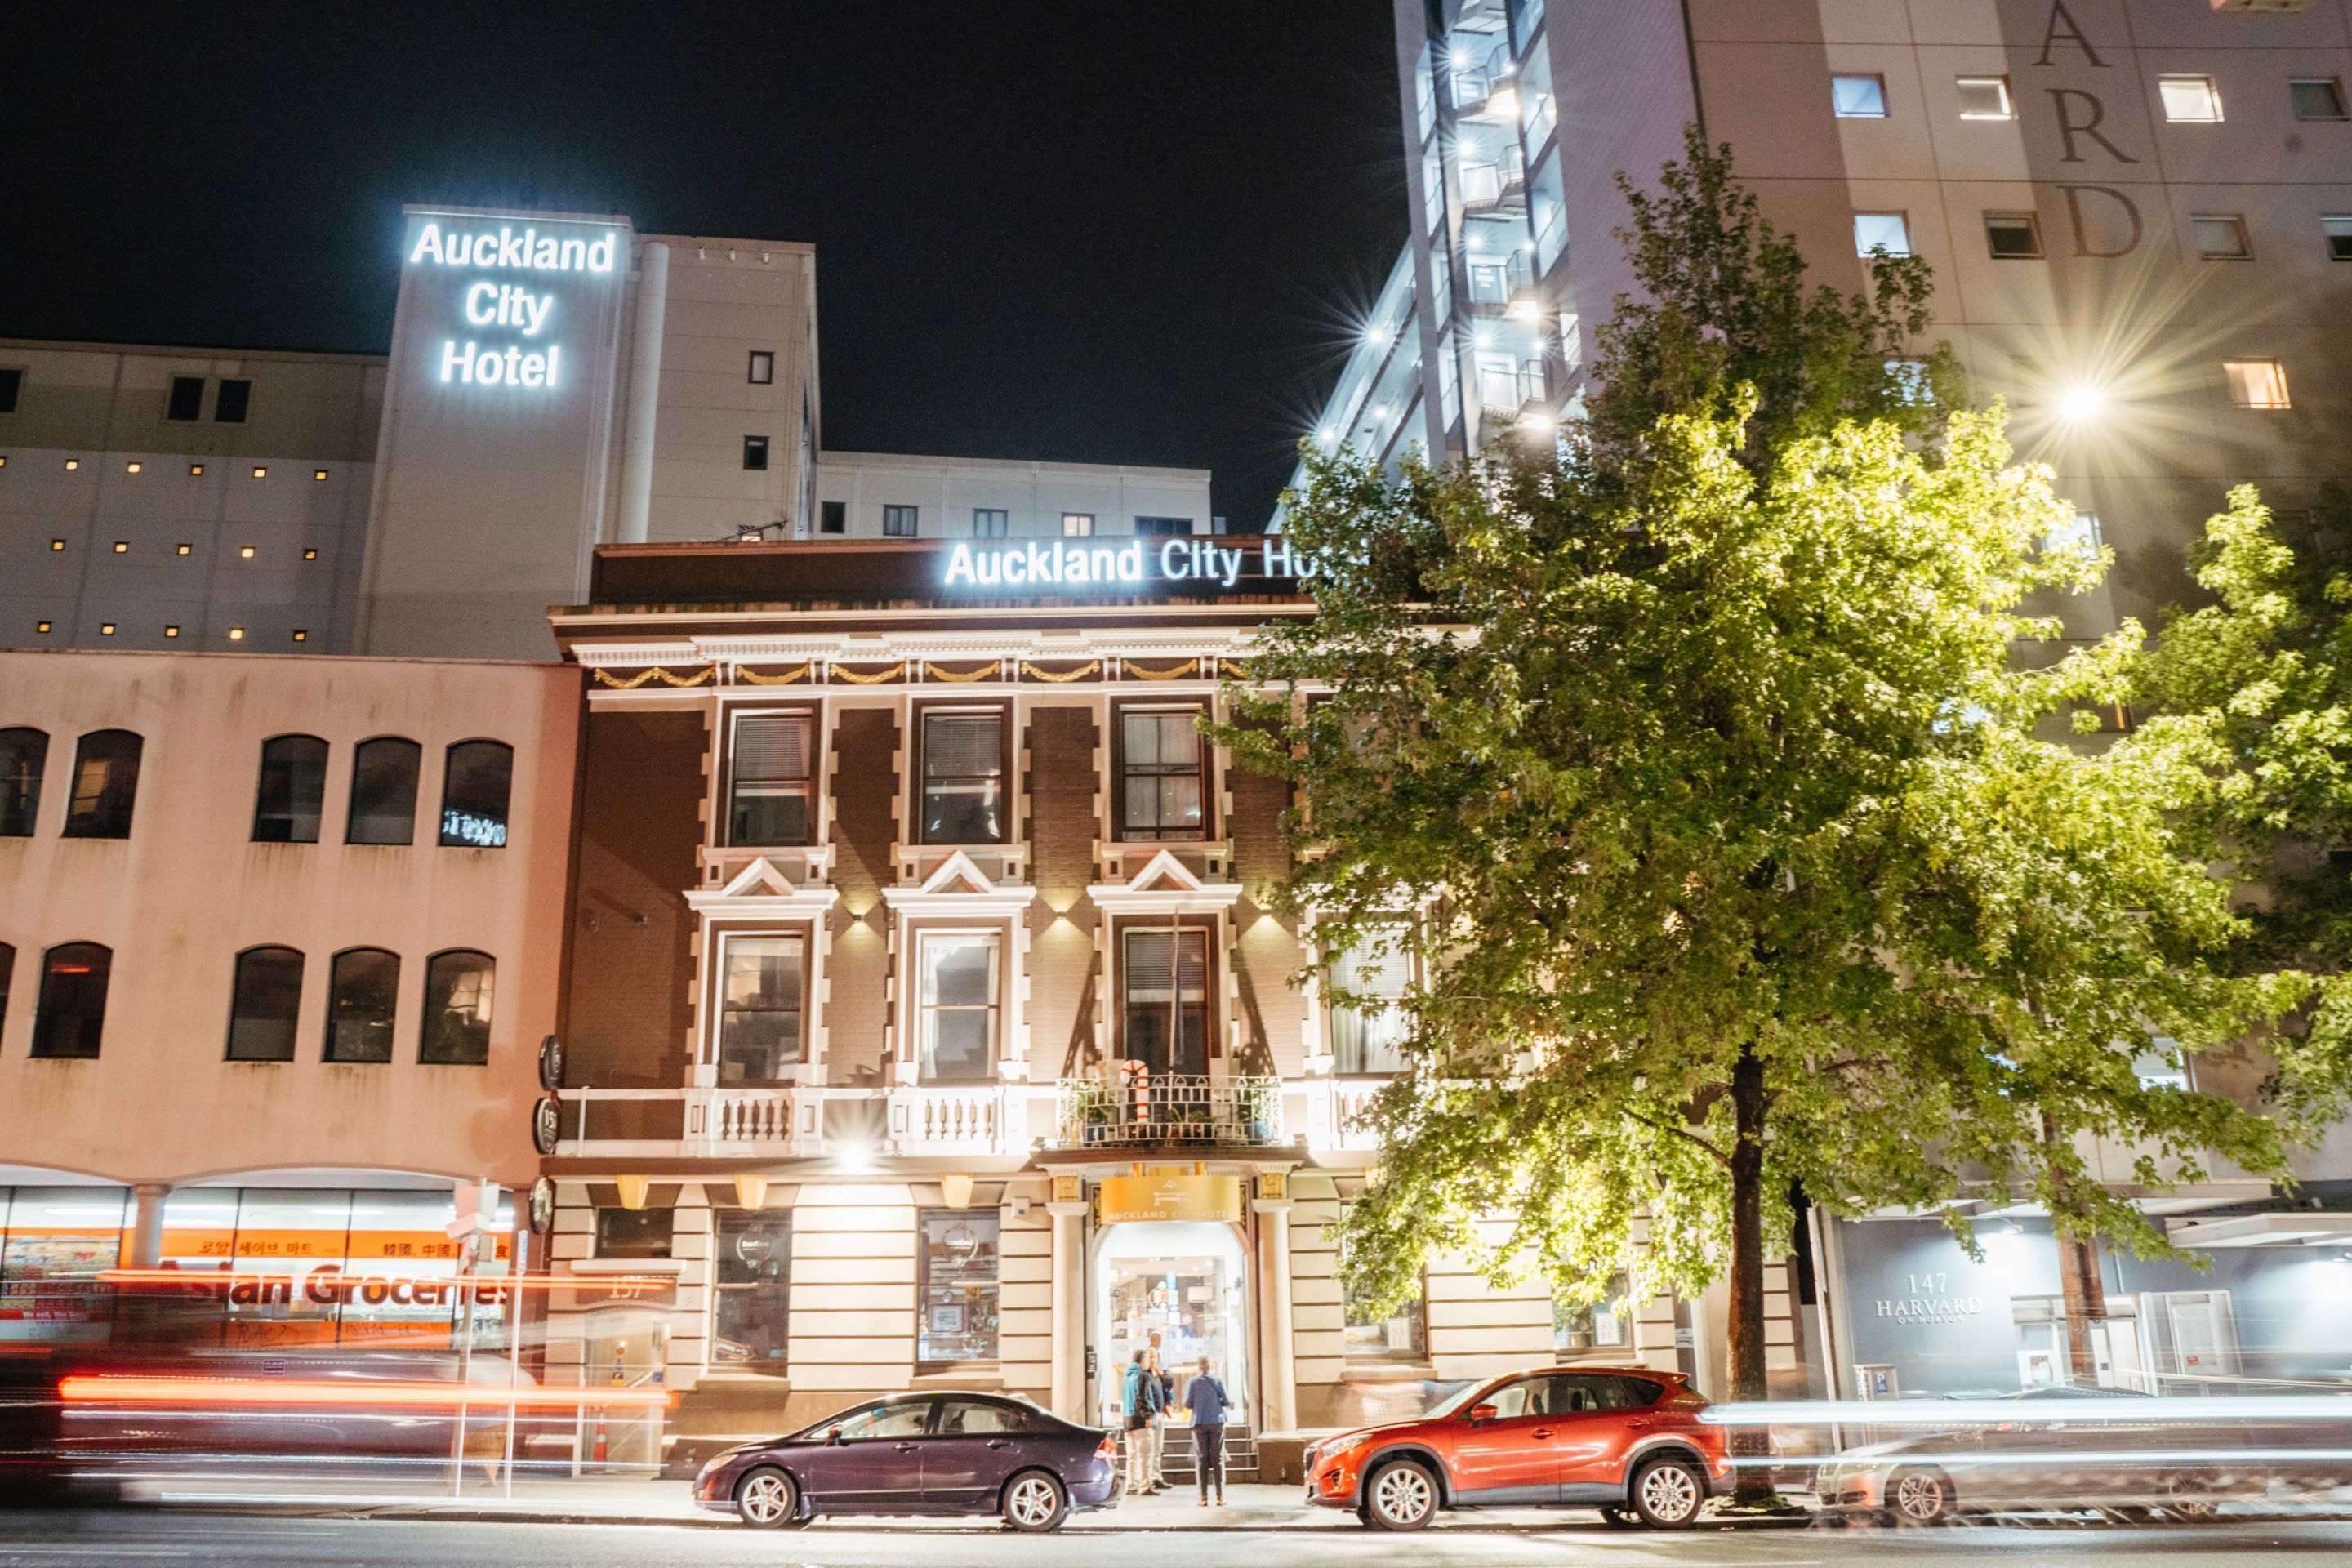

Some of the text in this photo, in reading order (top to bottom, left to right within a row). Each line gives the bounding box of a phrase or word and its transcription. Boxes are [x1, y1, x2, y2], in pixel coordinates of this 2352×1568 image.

[410, 223, 615, 272] Auckland
[466, 282, 553, 336] City
[440, 340, 559, 386] Hotel
[943, 540, 1143, 585] Auckland
[1160, 539, 1243, 586] City
[1109, 1210, 1167, 1220] AUCKLAND
[1201, 1209, 1232, 1218] HOTE
[1908, 1272, 1947, 1294] 147
[1875, 1297, 1984, 1317] HARVARD
